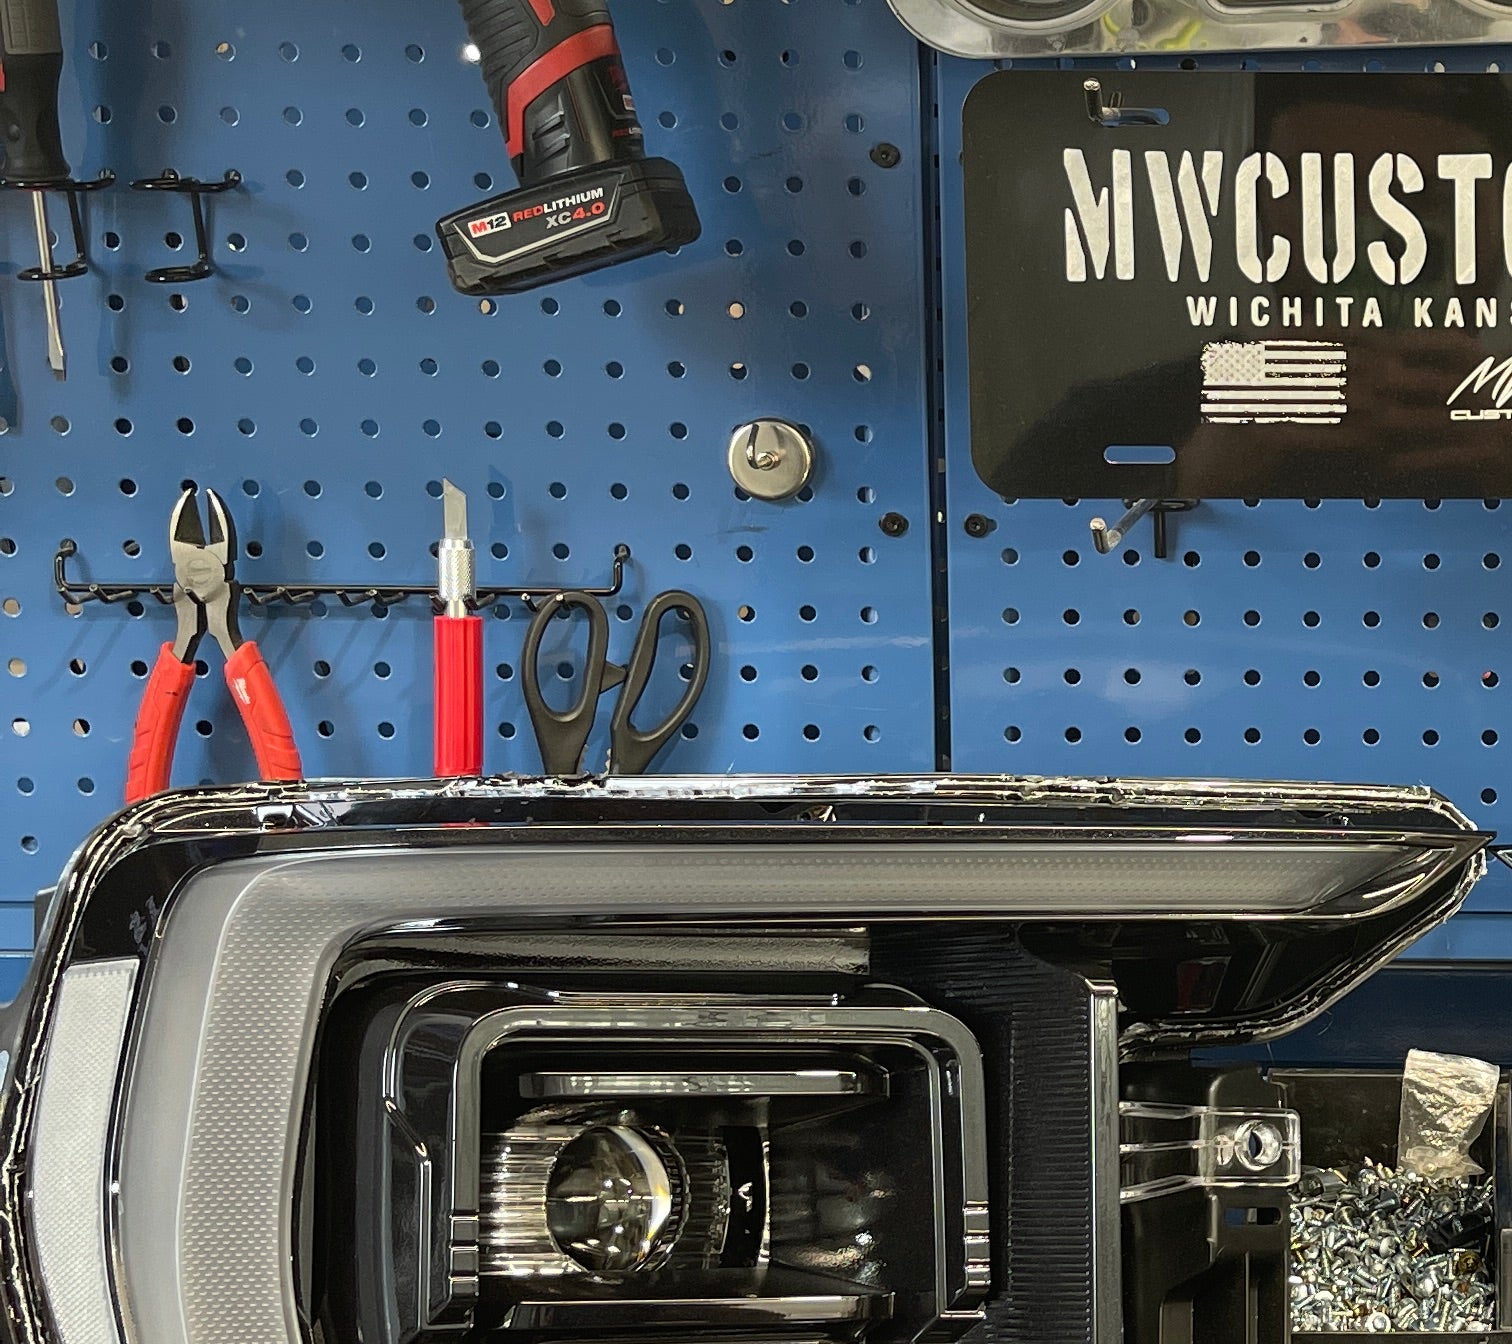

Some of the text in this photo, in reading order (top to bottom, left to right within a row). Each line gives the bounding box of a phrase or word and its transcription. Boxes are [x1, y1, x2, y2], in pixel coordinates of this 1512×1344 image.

[472, 187, 605, 235] M12 REDLITHIUM
[546, 201, 606, 229] XC4.0
[1186, 295, 1383, 327] WICHITA
